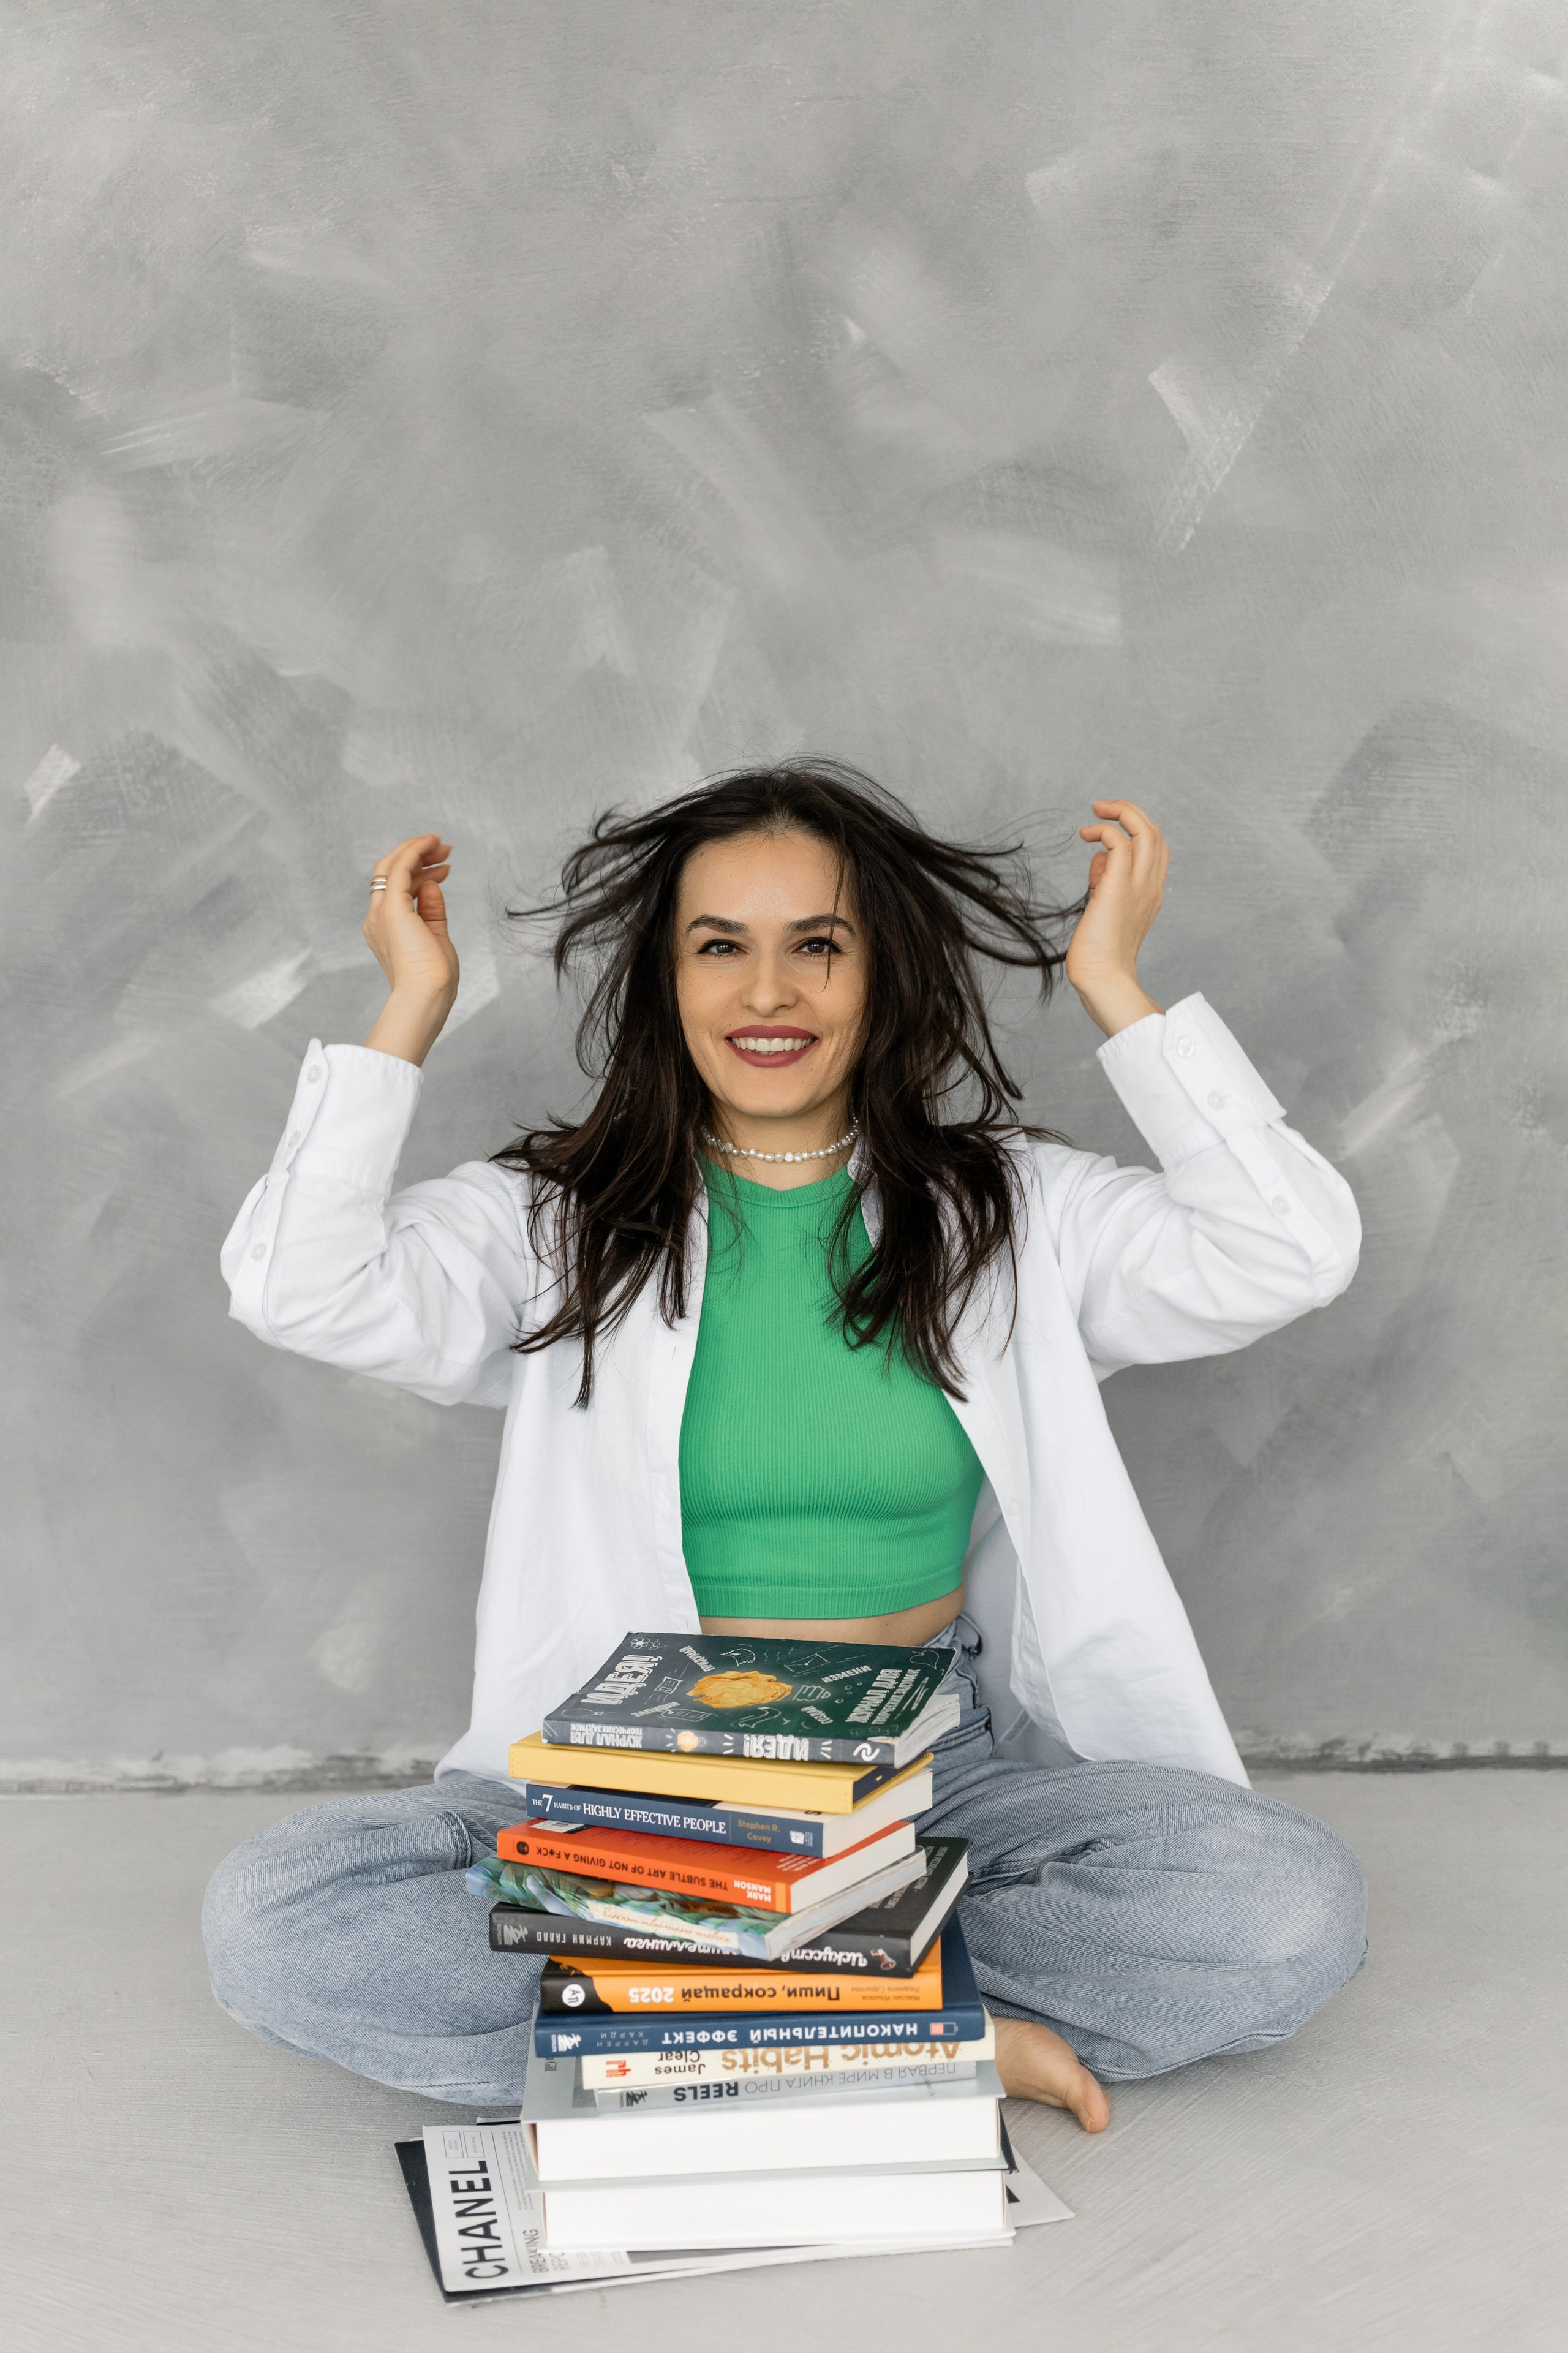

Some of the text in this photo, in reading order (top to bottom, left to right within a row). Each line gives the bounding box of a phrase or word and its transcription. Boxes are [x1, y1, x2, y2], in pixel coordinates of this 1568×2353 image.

[679, 1645, 715, 1672] ПРИДУМАЙ
[581, 1655, 663, 1705] ИДЕЯ!
[821, 1665, 872, 1683] ИЗМЕНИ
[845, 1669, 902, 1723] ЖУРНАЛ ДЛЯ
[871, 1669, 921, 1725] ТВОРЧЕСКИХ ЗАДУМОК
[630, 1701, 681, 1717] ЗАПИШИ
[800, 1705, 834, 1724] СОЗДАЙ
[570, 1723, 643, 1735] ТВОРЧЕСКИХ ЗАДУМОК
[570, 1730, 643, 1748] ЖУРНАЛ ДЛЯ
[743, 1734, 809, 1761] ИДЕЯ!
[542, 1794, 554, 1813] 7
[554, 1802, 573, 1811] HABITS
[583, 1803, 622, 1819] HIGHLY
[624, 1808, 681, 1828] EFFECTIVE
[684, 1817, 726, 1835] PEOPLE
[737, 1819, 771, 1832] Stephen
[747, 1832, 772, 1844] Covey
[573, 1854, 606, 1867] GIVING
[608, 1862, 628, 1871] NOT
[631, 1865, 644, 1874] OF
[647, 1867, 666, 1878] ART
[669, 1871, 706, 1886] SUBTLE
[709, 1880, 728, 1891] THE
[734, 1879, 771, 1894] MANSON
[747, 1890, 771, 1902] MARK
[603, 1906, 639, 1923] Блокнот
[641, 1916, 693, 1935] творческого
[537, 1931, 611, 1946] КАРМИН ГАЛЛО
[781, 1946, 868, 1967] Искусств
[628, 1984, 840, 2003] Пиши, сокращай 2025
[662, 2023, 918, 2045] НАКОПИТЕЛЬНЫЙ ЭФФЕКТ
[597, 2039, 649, 2048] ДАРРЕН
[658, 2050, 701, 2063] Clear
[722, 2041, 961, 2074] Atomic Habits
[654, 2064, 706, 2075] James
[673, 2063, 957, 2102] ПЕРВАЯ В МИРЕ КНИГА ПРО REELS
[448, 2160, 509, 2279] CHANEL
[522, 2229, 549, 2273] BREAKING
